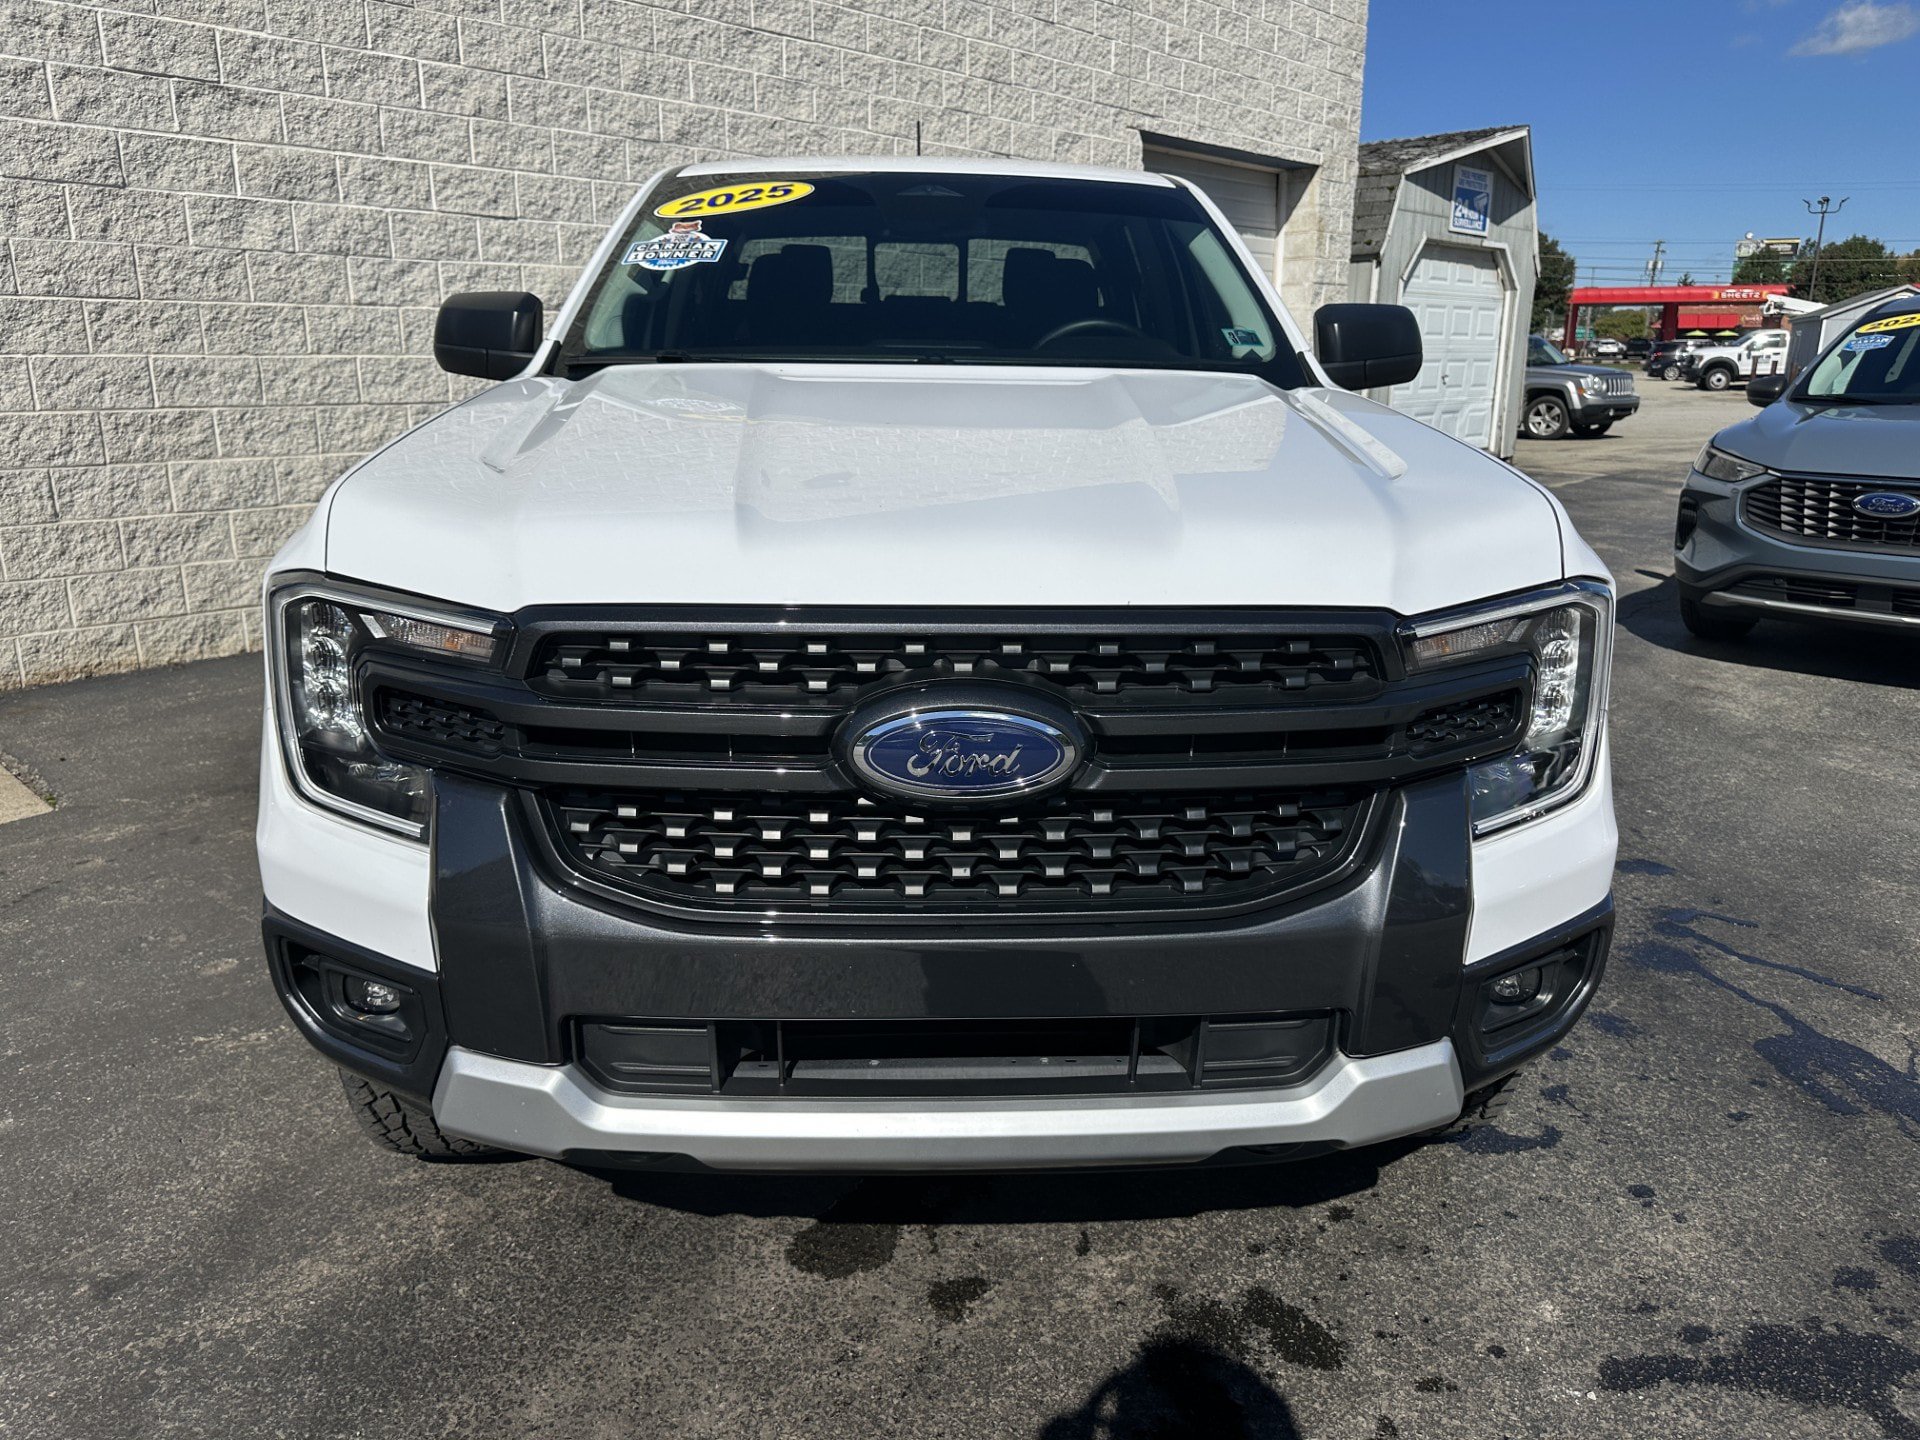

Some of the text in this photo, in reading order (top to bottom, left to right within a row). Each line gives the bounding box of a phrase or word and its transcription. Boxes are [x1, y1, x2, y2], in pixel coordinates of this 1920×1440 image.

[675, 184, 794, 214] 2025
[636, 242, 718, 251] CARFAX
[645, 251, 714, 259] OWNER
[1720, 291, 1761, 299] SHEETZ
[1864, 316, 1920, 331] 202
[1867, 497, 1905, 512] Ford
[906, 730, 1024, 777] Ford
